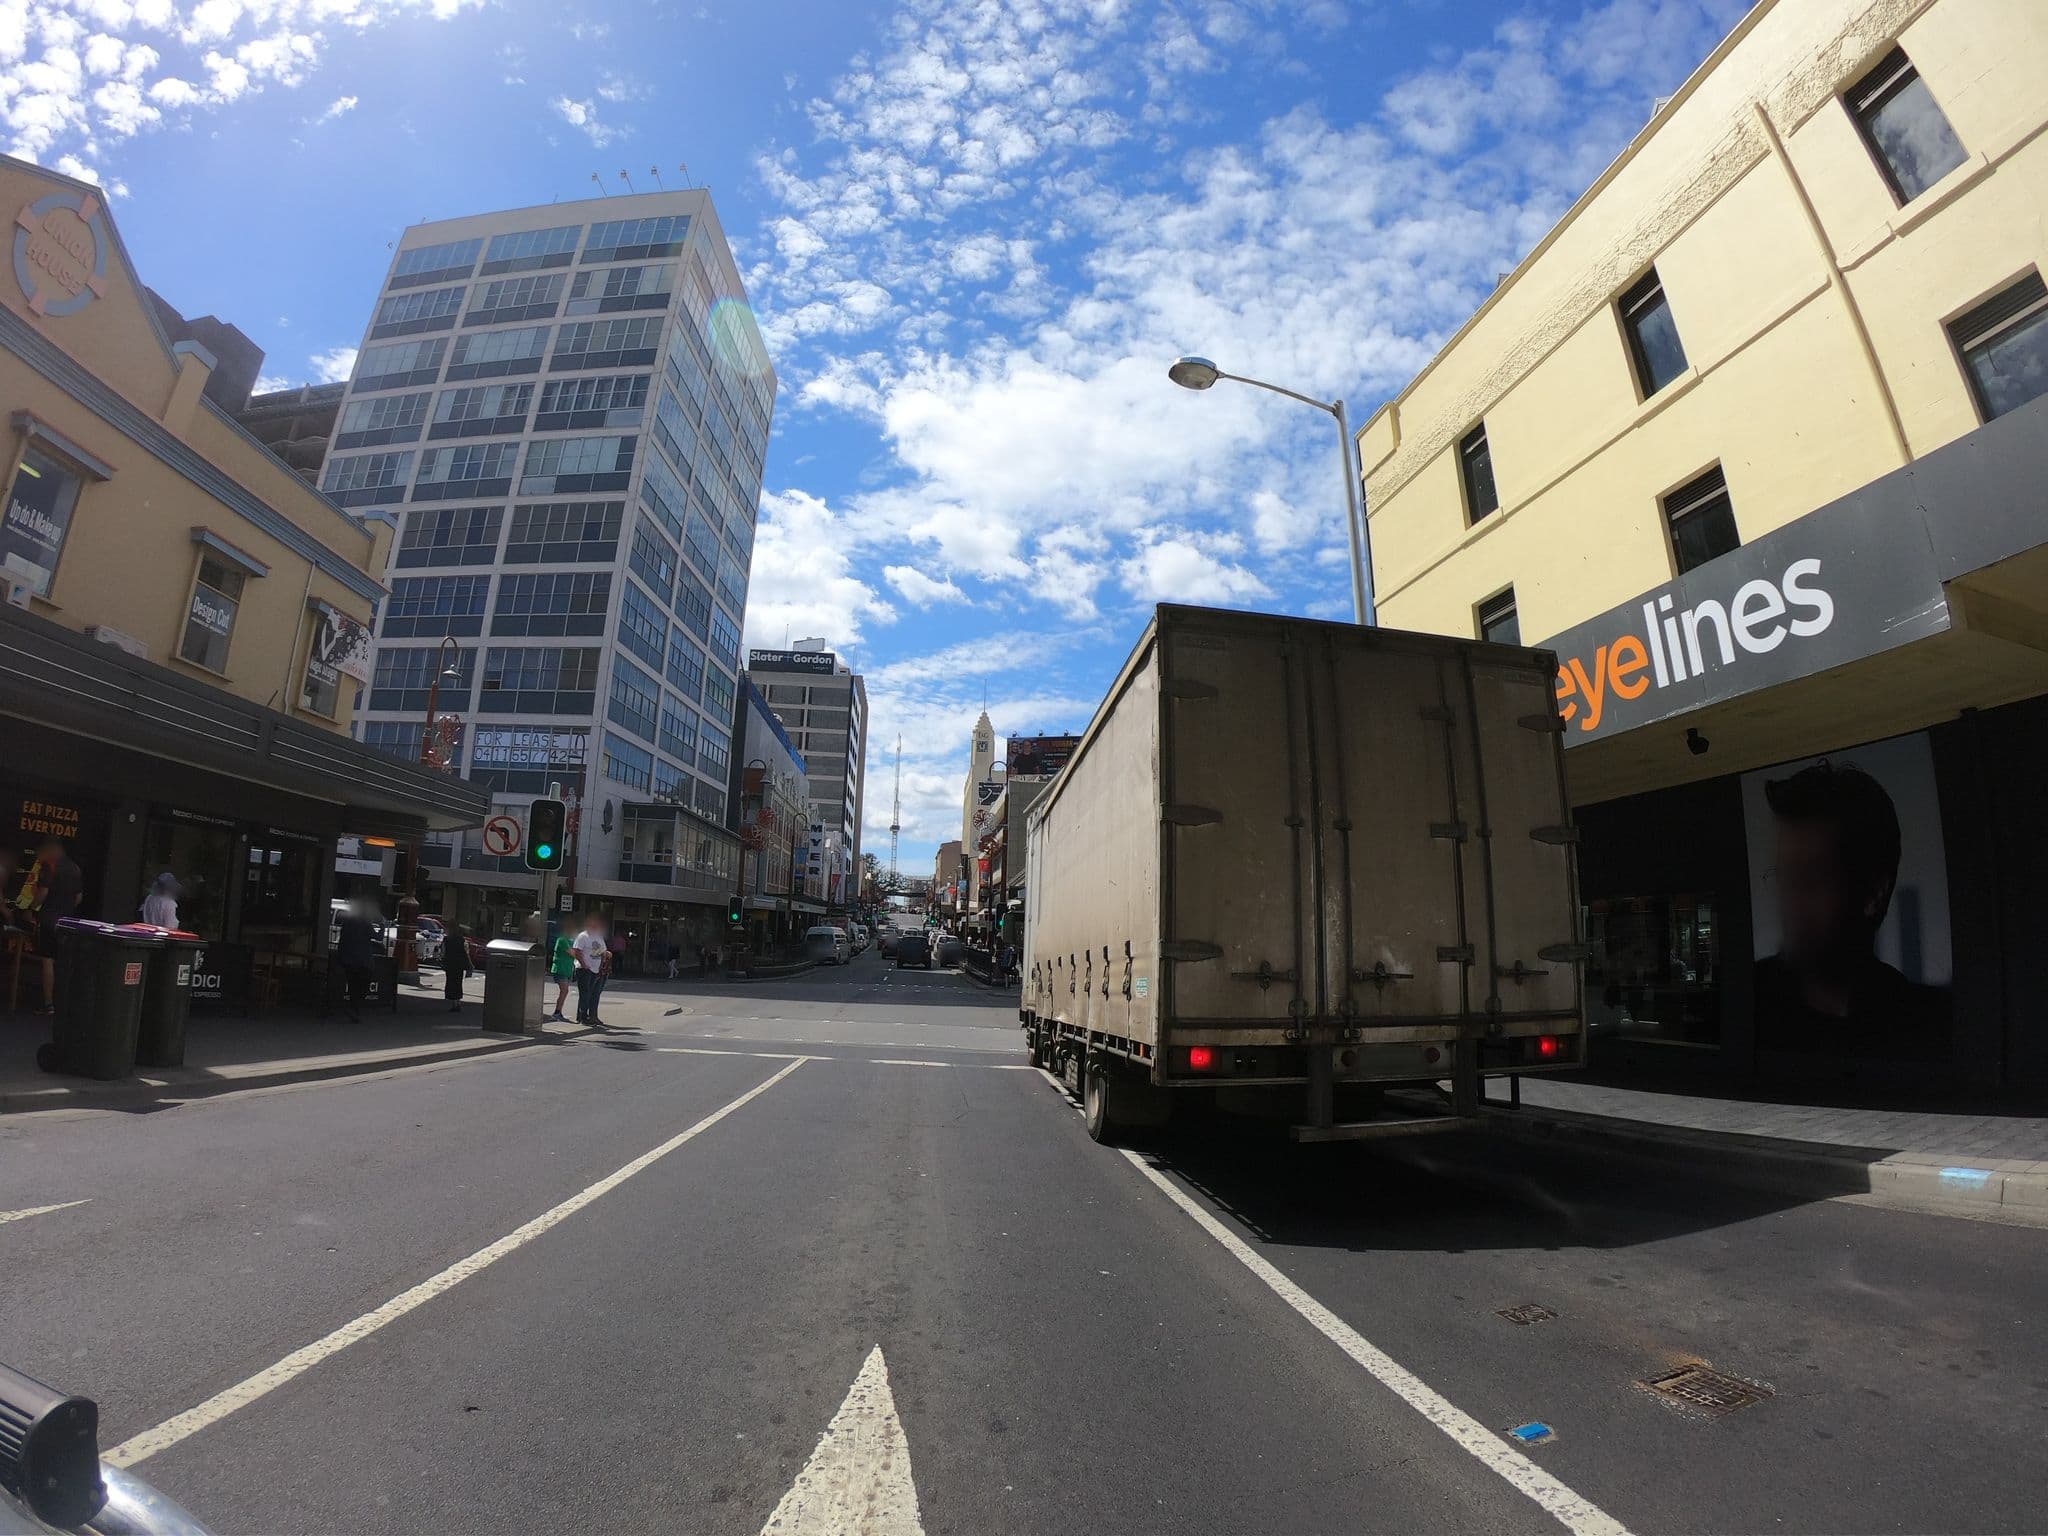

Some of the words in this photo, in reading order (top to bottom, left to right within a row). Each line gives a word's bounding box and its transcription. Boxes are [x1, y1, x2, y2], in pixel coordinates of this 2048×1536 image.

[42, 214, 95, 271] UNION
[9, 499, 21, 524] Up
[193, 596, 217, 623] Design
[1556, 558, 1834, 731] eyelines
[750, 651, 783, 662] Slater
[793, 654, 832, 664] Gordon
[476, 732, 503, 745] FOR
[513, 734, 561, 748] LEASE
[23, 801, 43, 815] EAT
[45, 805, 79, 822] PIZZA
[20, 817, 78, 838] EVERYDAY
[807, 825, 823, 875] MYER
[192, 973, 221, 989] DICI
